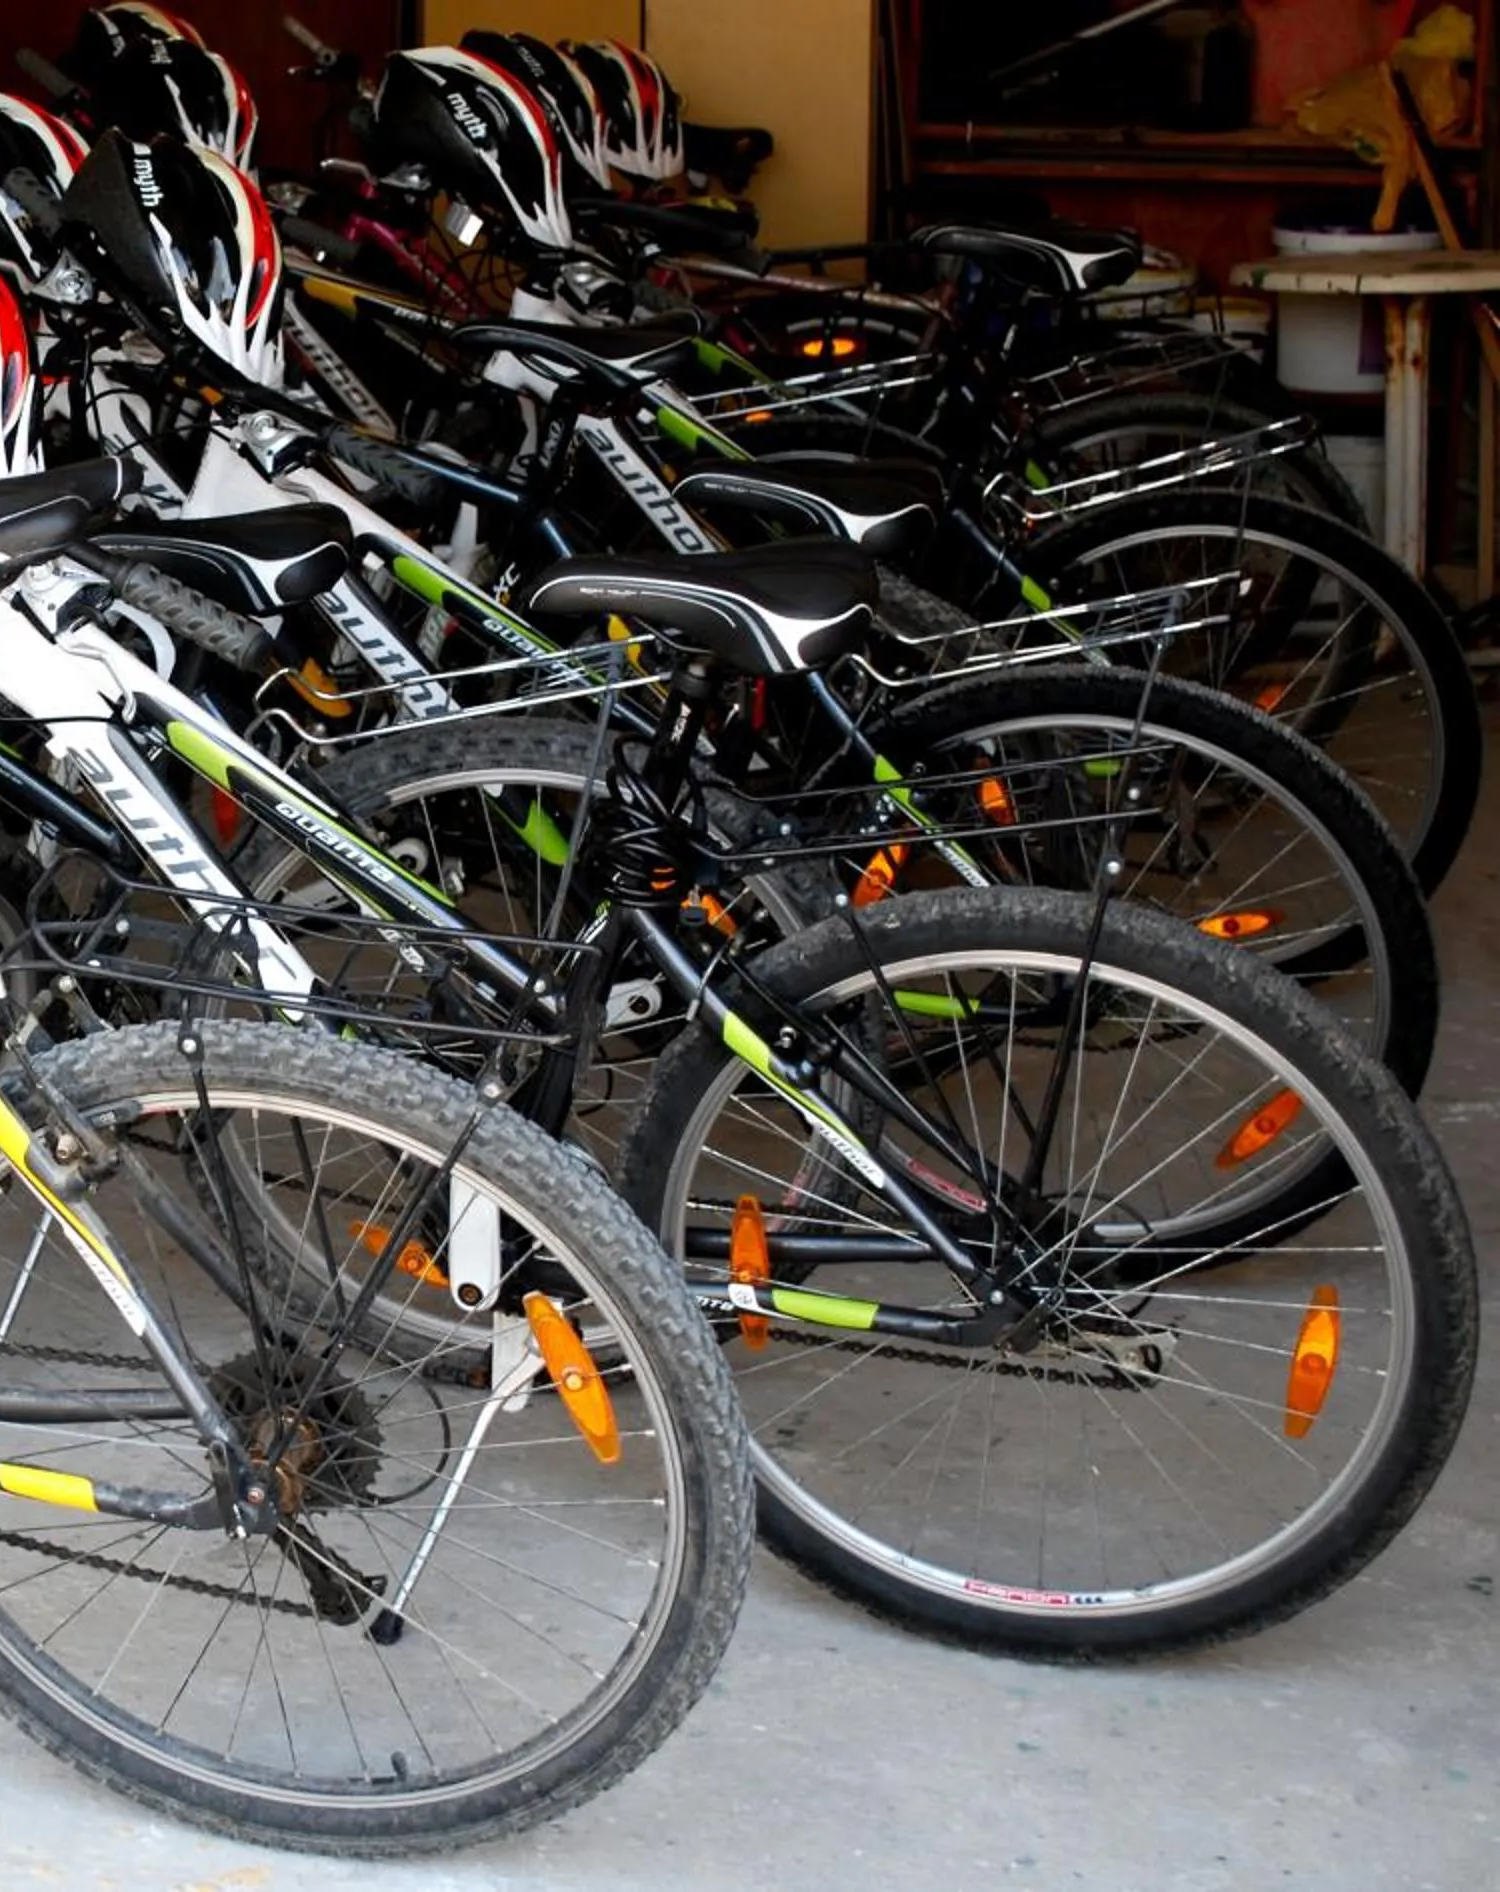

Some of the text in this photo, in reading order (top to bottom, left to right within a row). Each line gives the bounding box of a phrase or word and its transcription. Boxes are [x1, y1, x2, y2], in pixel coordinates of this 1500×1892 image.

[446, 92, 488, 139] myth
[132, 158, 165, 208] myth
[580, 427, 707, 552] autho
